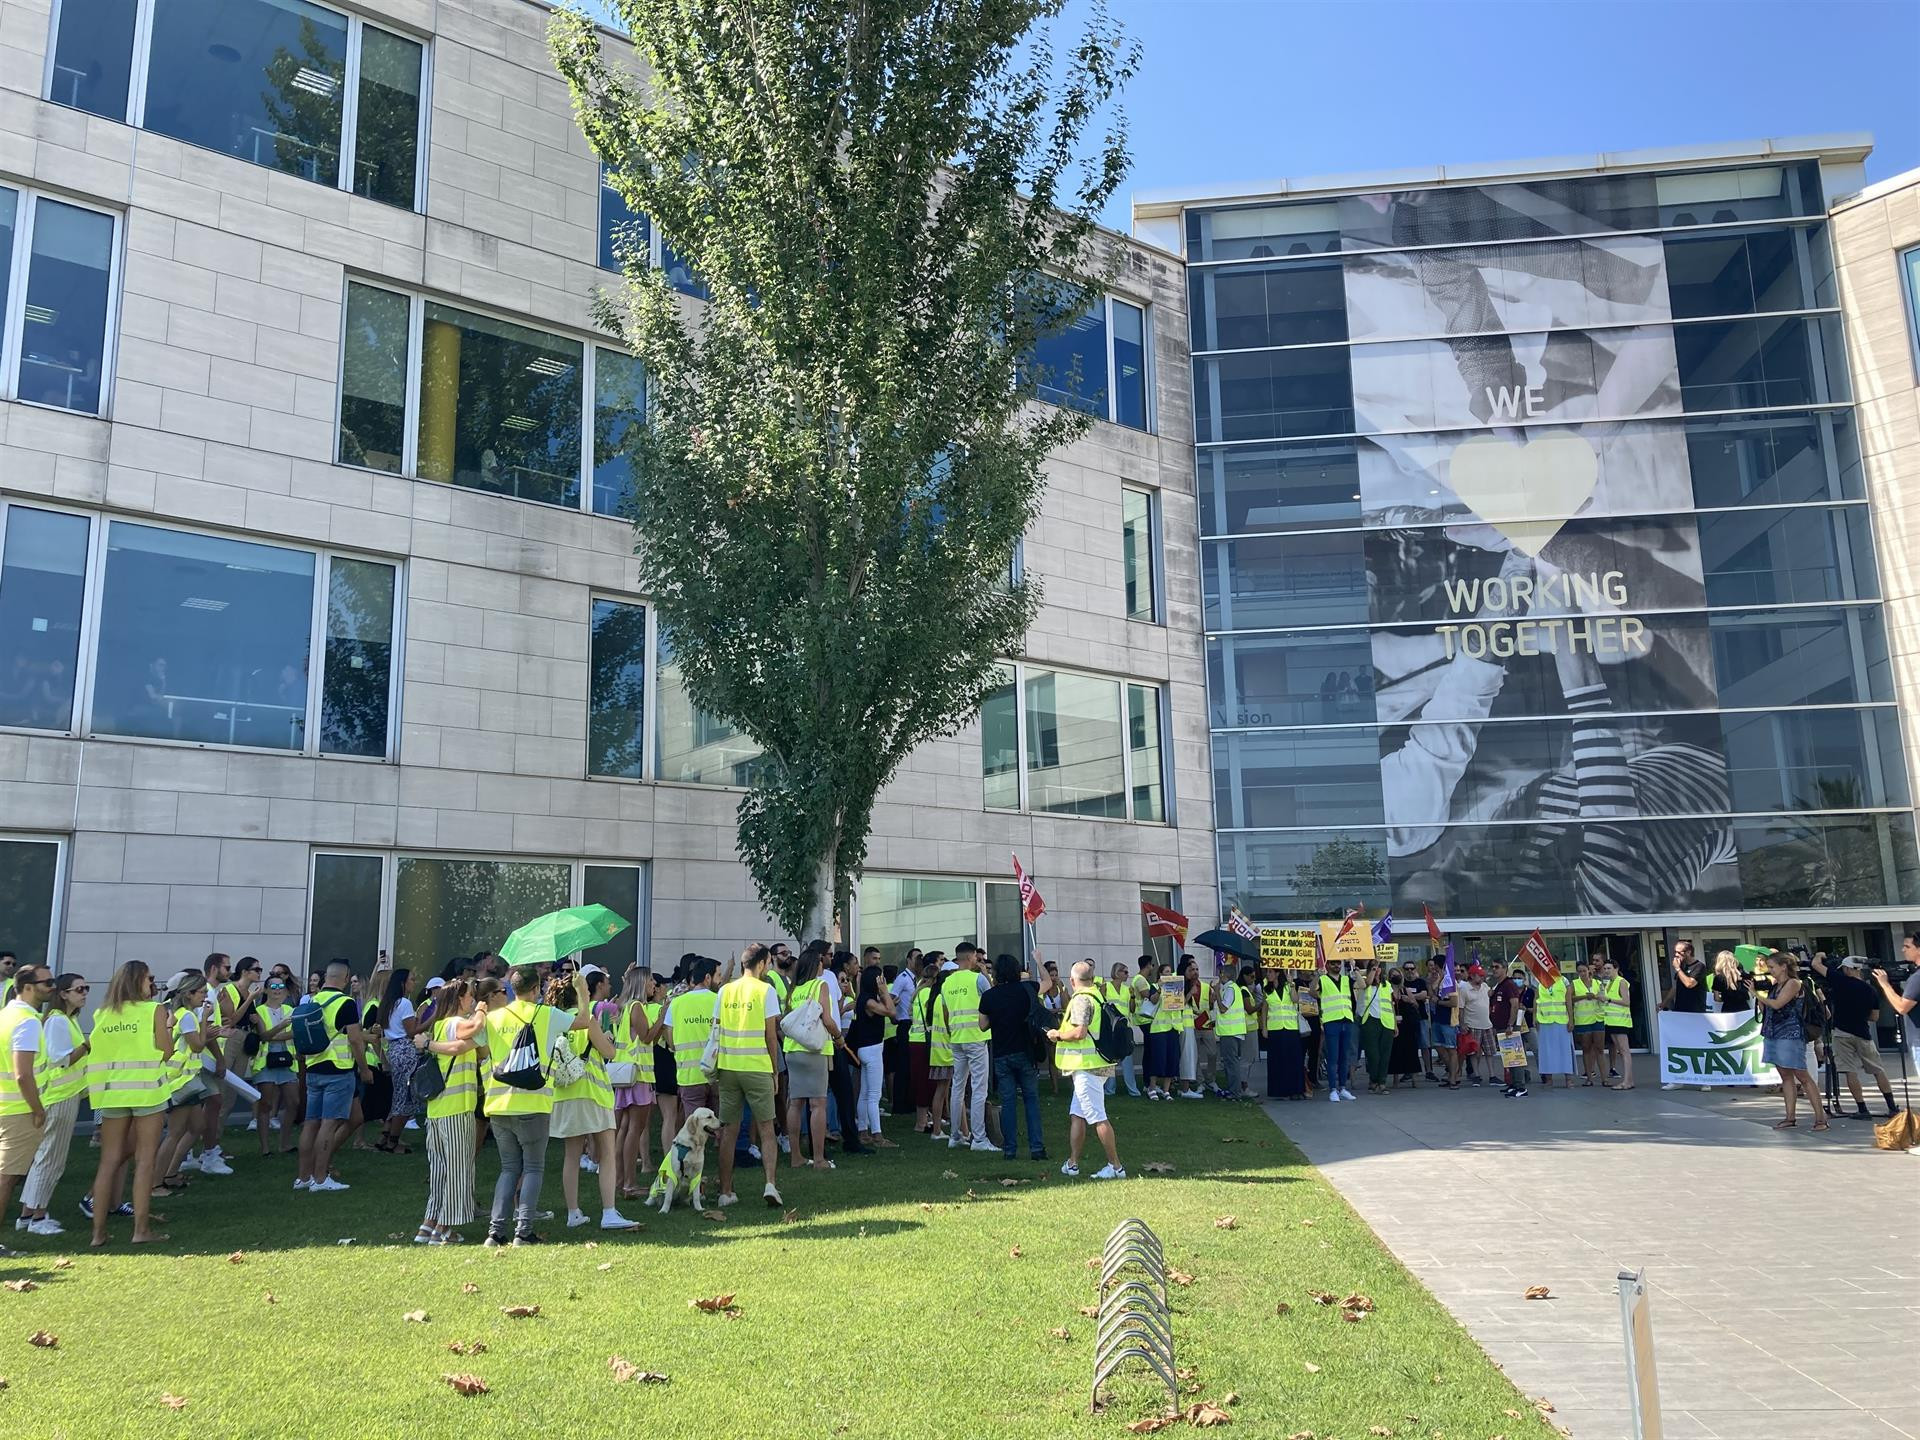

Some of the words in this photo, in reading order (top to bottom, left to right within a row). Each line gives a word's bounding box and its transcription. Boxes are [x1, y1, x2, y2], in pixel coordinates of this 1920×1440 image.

[1485, 384, 1546, 418] WE
[1443, 570, 1628, 614] WORKING
[1435, 617, 1647, 660] TOGETHER
[1217, 709, 1272, 726] Vsion
[1261, 938, 1279, 946] BILLETE
[1280, 939, 1287, 947] DE
[1270, 948, 1293, 956] SALARIO
[1261, 958, 1285, 967] DESDE
[1288, 958, 1314, 969] 2017
[102, 1021, 138, 1033] vueling
[684, 1014, 714, 1027] vueling
[1667, 1047, 1777, 1076] STAVL
